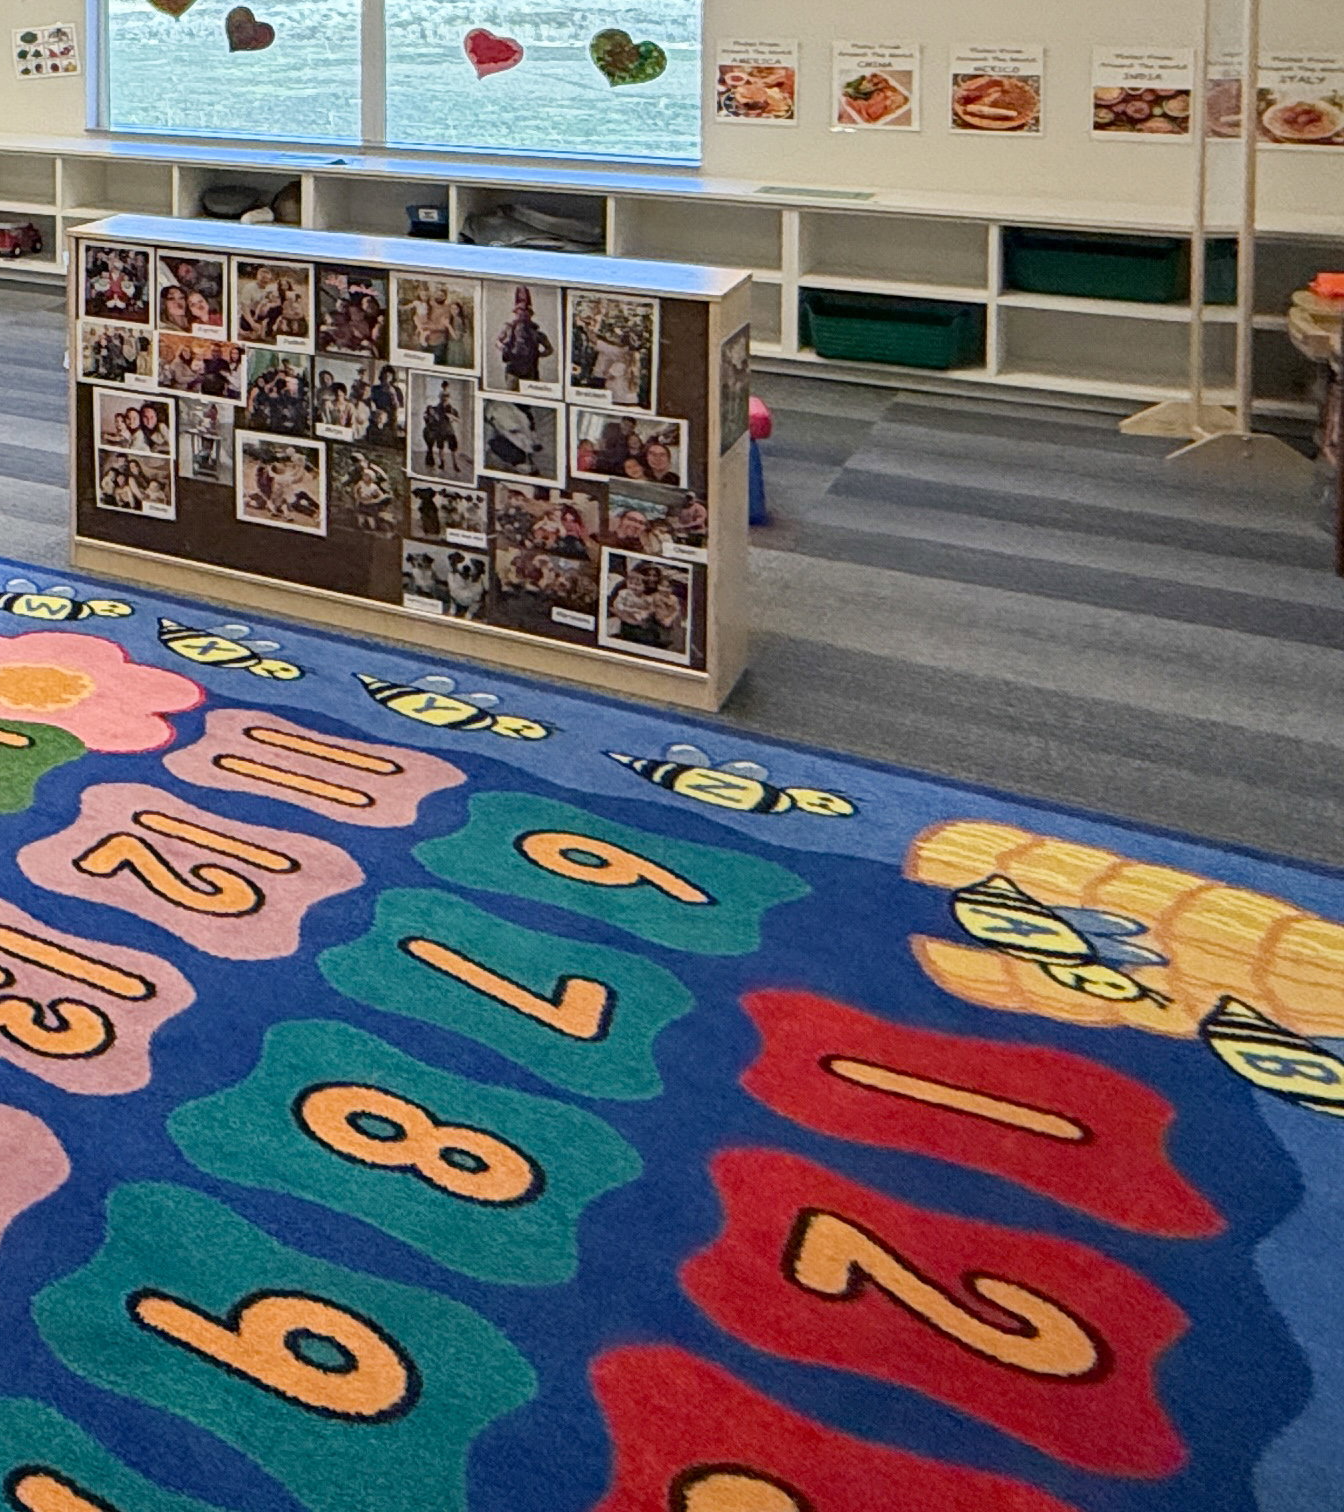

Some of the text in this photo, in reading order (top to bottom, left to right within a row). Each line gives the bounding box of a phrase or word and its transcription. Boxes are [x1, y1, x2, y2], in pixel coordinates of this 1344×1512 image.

[731, 57, 782, 65] AMERICA
[1122, 72, 1163, 81] INDIA
[1279, 75, 1326, 84] ITALY
[25, 599, 67, 616] W
[183, 639, 237, 657] X
[412, 696, 462, 714] Y
[212, 725, 405, 809] 11
[73, 808, 301, 918] 12
[512, 829, 717, 907] 6
[968, 907, 1060, 937] A
[399, 934, 618, 1043] 7
[1235, 1048, 1343, 1086] B
[818, 1052, 1094, 1144] 1
[290, 1080, 547, 1209] 8
[781, 1205, 1113, 1386] 2
[124, 1285, 424, 1425] 9
